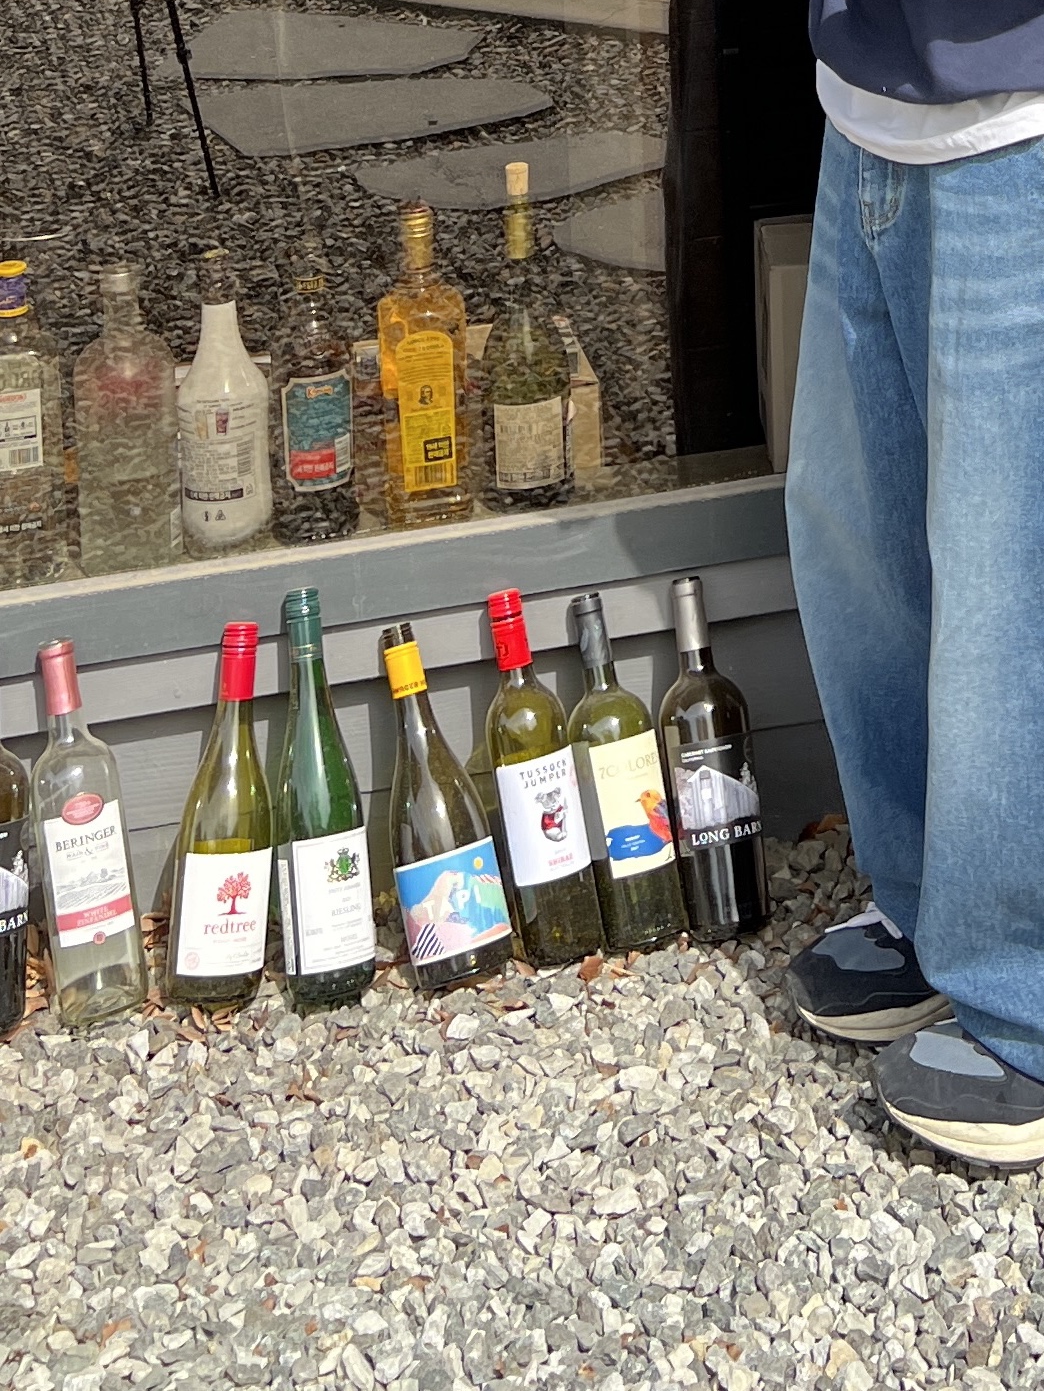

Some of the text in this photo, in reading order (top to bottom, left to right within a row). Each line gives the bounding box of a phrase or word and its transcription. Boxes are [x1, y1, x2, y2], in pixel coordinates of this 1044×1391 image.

[55, 825, 118, 852] BERINGER
[691, 828, 730, 846] LONG
[204, 918, 257, 935] redtree
